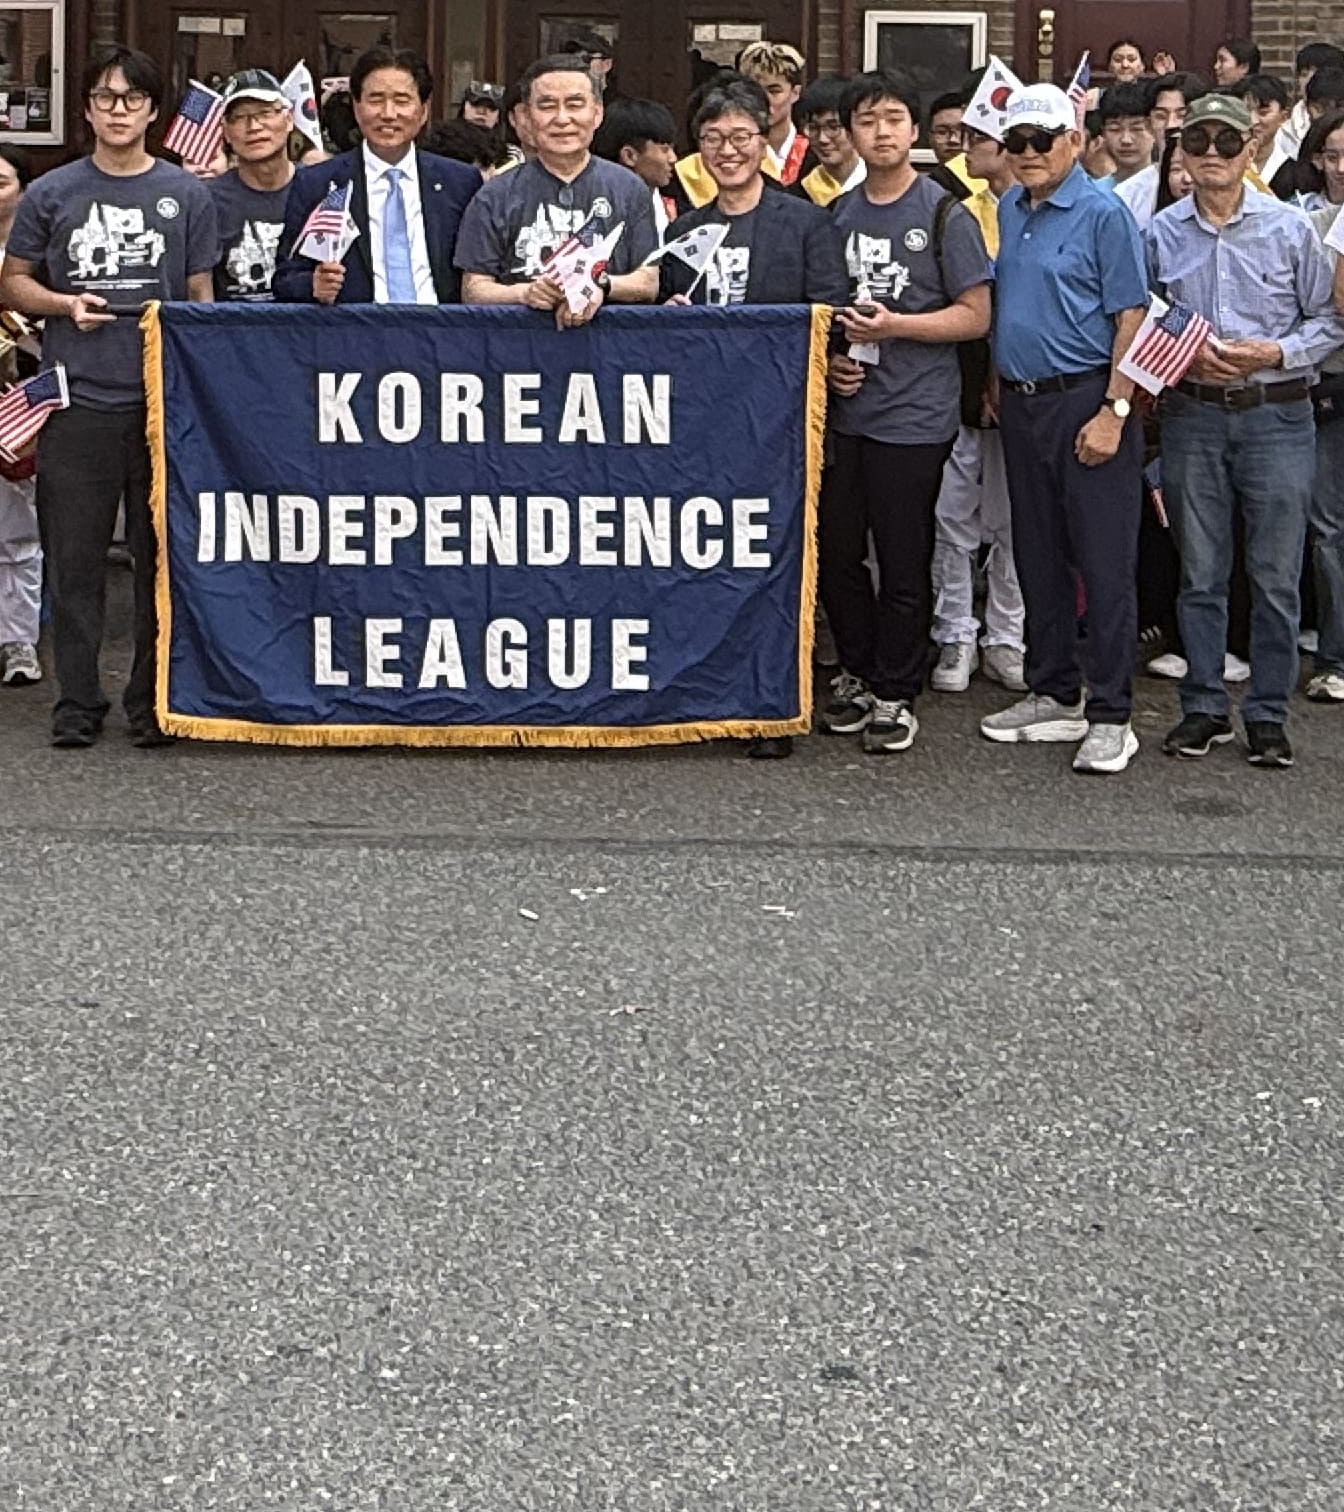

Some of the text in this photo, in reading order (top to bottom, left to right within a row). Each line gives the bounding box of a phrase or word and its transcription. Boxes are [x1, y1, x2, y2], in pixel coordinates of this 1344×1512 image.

[318, 371, 671, 445] KOREAN
[197, 491, 772, 570] INDEPENDENCE
[313, 616, 651, 691] LEAGUE
